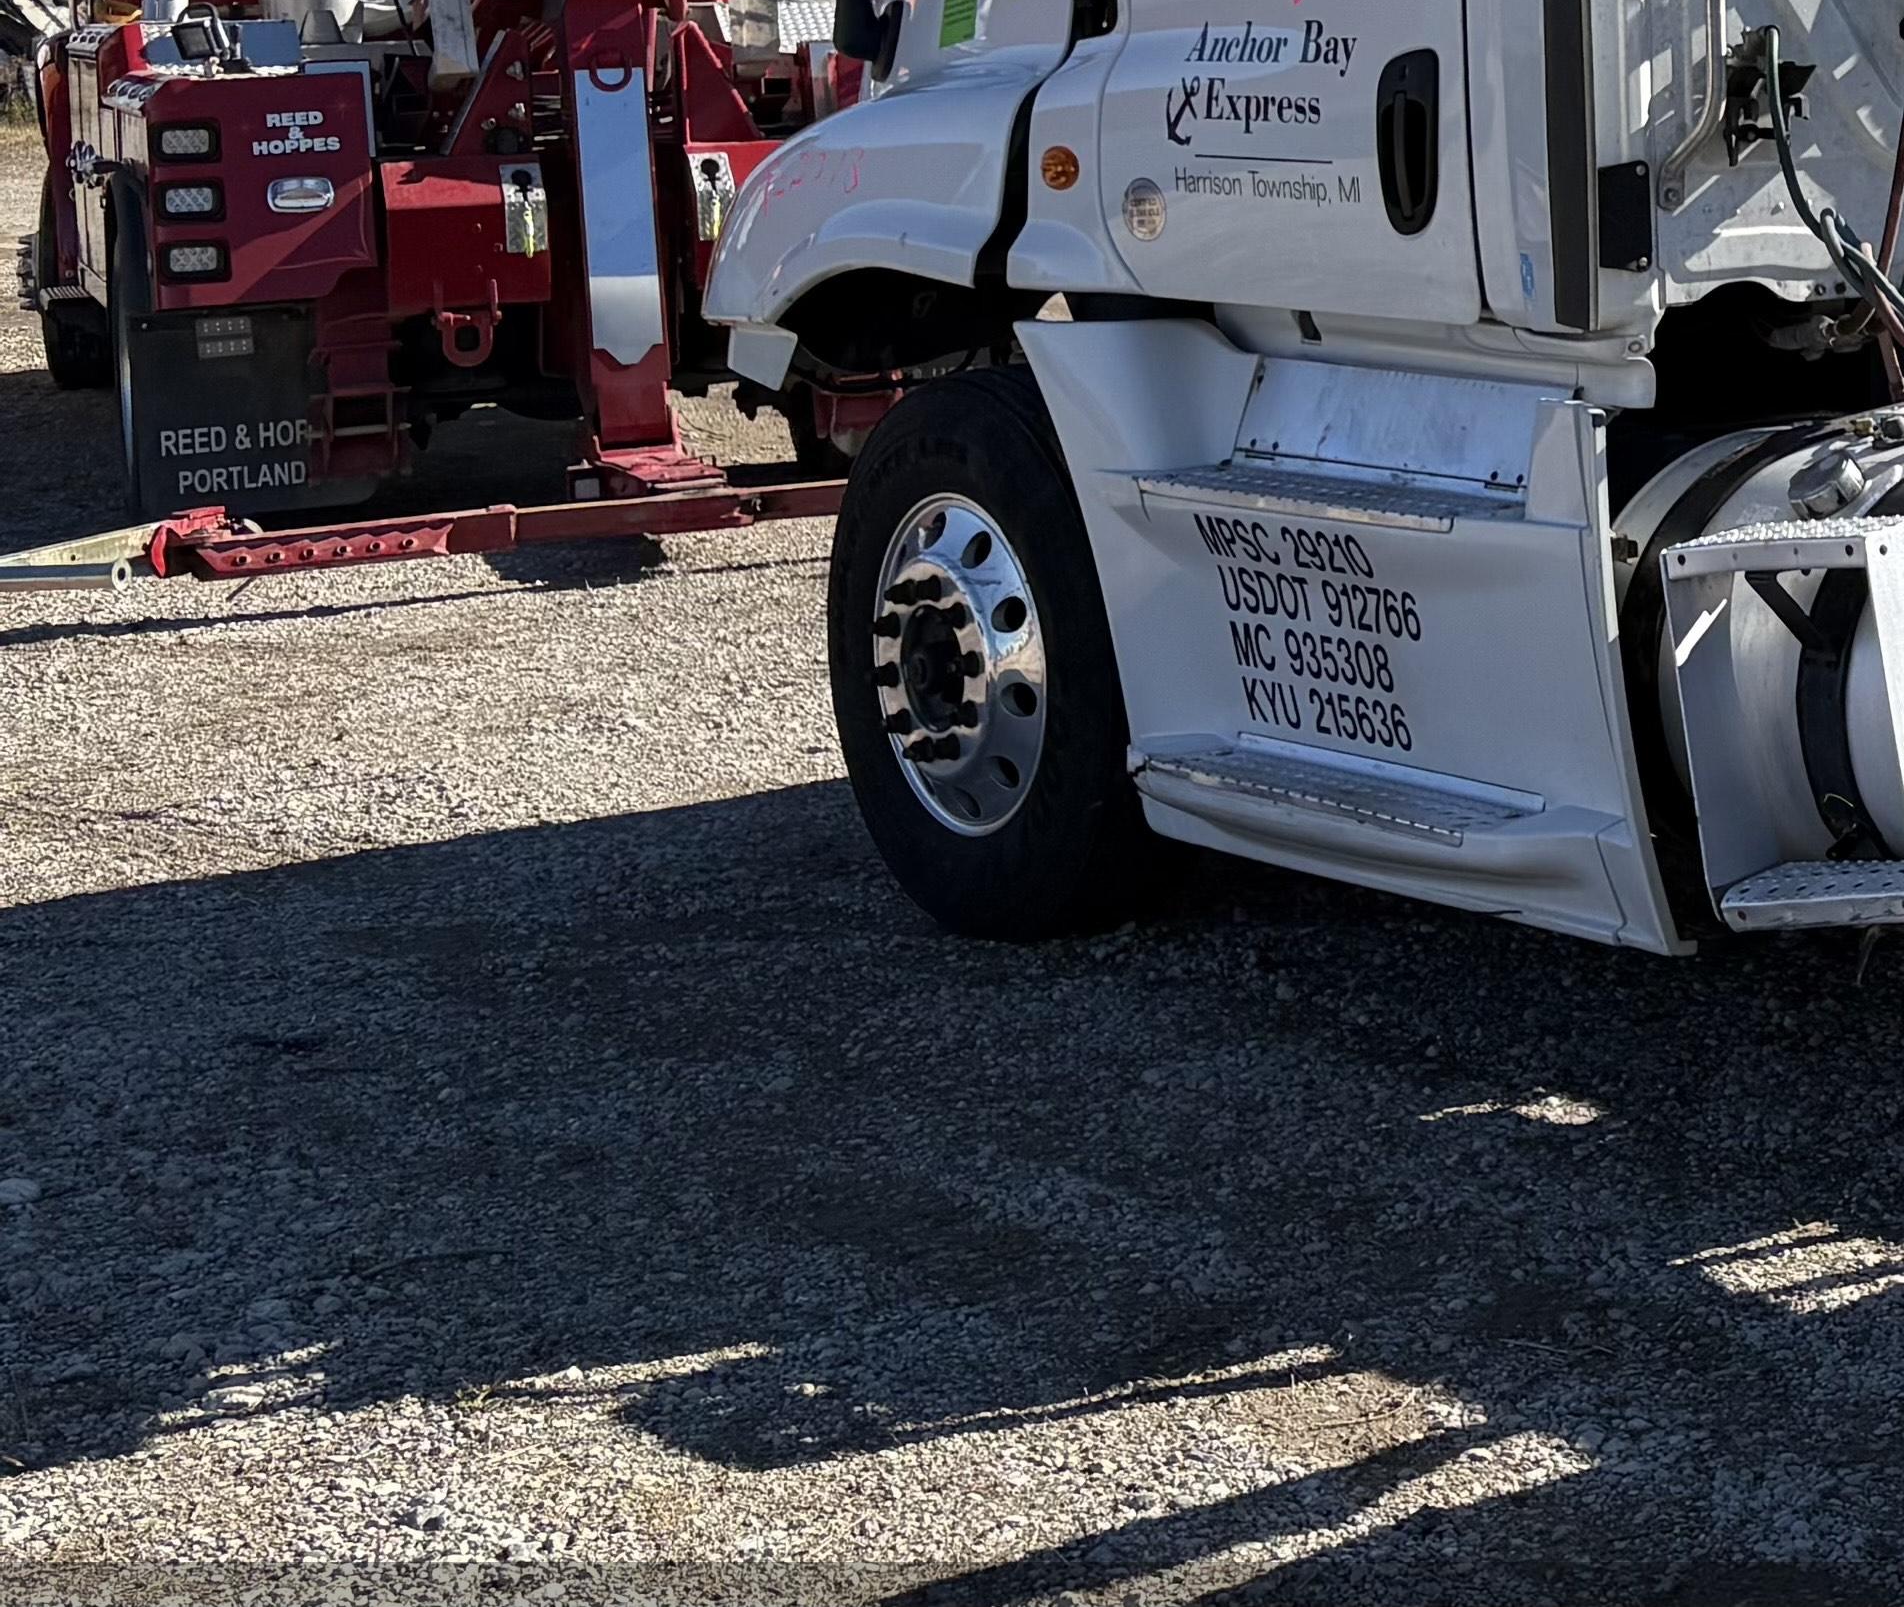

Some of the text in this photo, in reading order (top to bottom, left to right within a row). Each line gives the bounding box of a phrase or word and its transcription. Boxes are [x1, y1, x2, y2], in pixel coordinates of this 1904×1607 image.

[1185, 19, 1358, 77] Anchor Bay
[266, 111, 324, 128] REED
[1204, 77, 1321, 134] Express
[252, 136, 341, 156] HOPPES
[288, 126, 305, 140] &
[1175, 166, 1361, 207] Harrison Township, MI
[160, 426, 227, 457] REED
[235, 424, 252, 450] &
[178, 461, 307, 494] PORTLAND
[1193, 513, 1374, 579] MPSC 29210
[1217, 564, 1422, 642] USDOT 912766
[1229, 620, 1395, 694] MC 935308
[1241, 675, 1413, 752] KYU 215636
